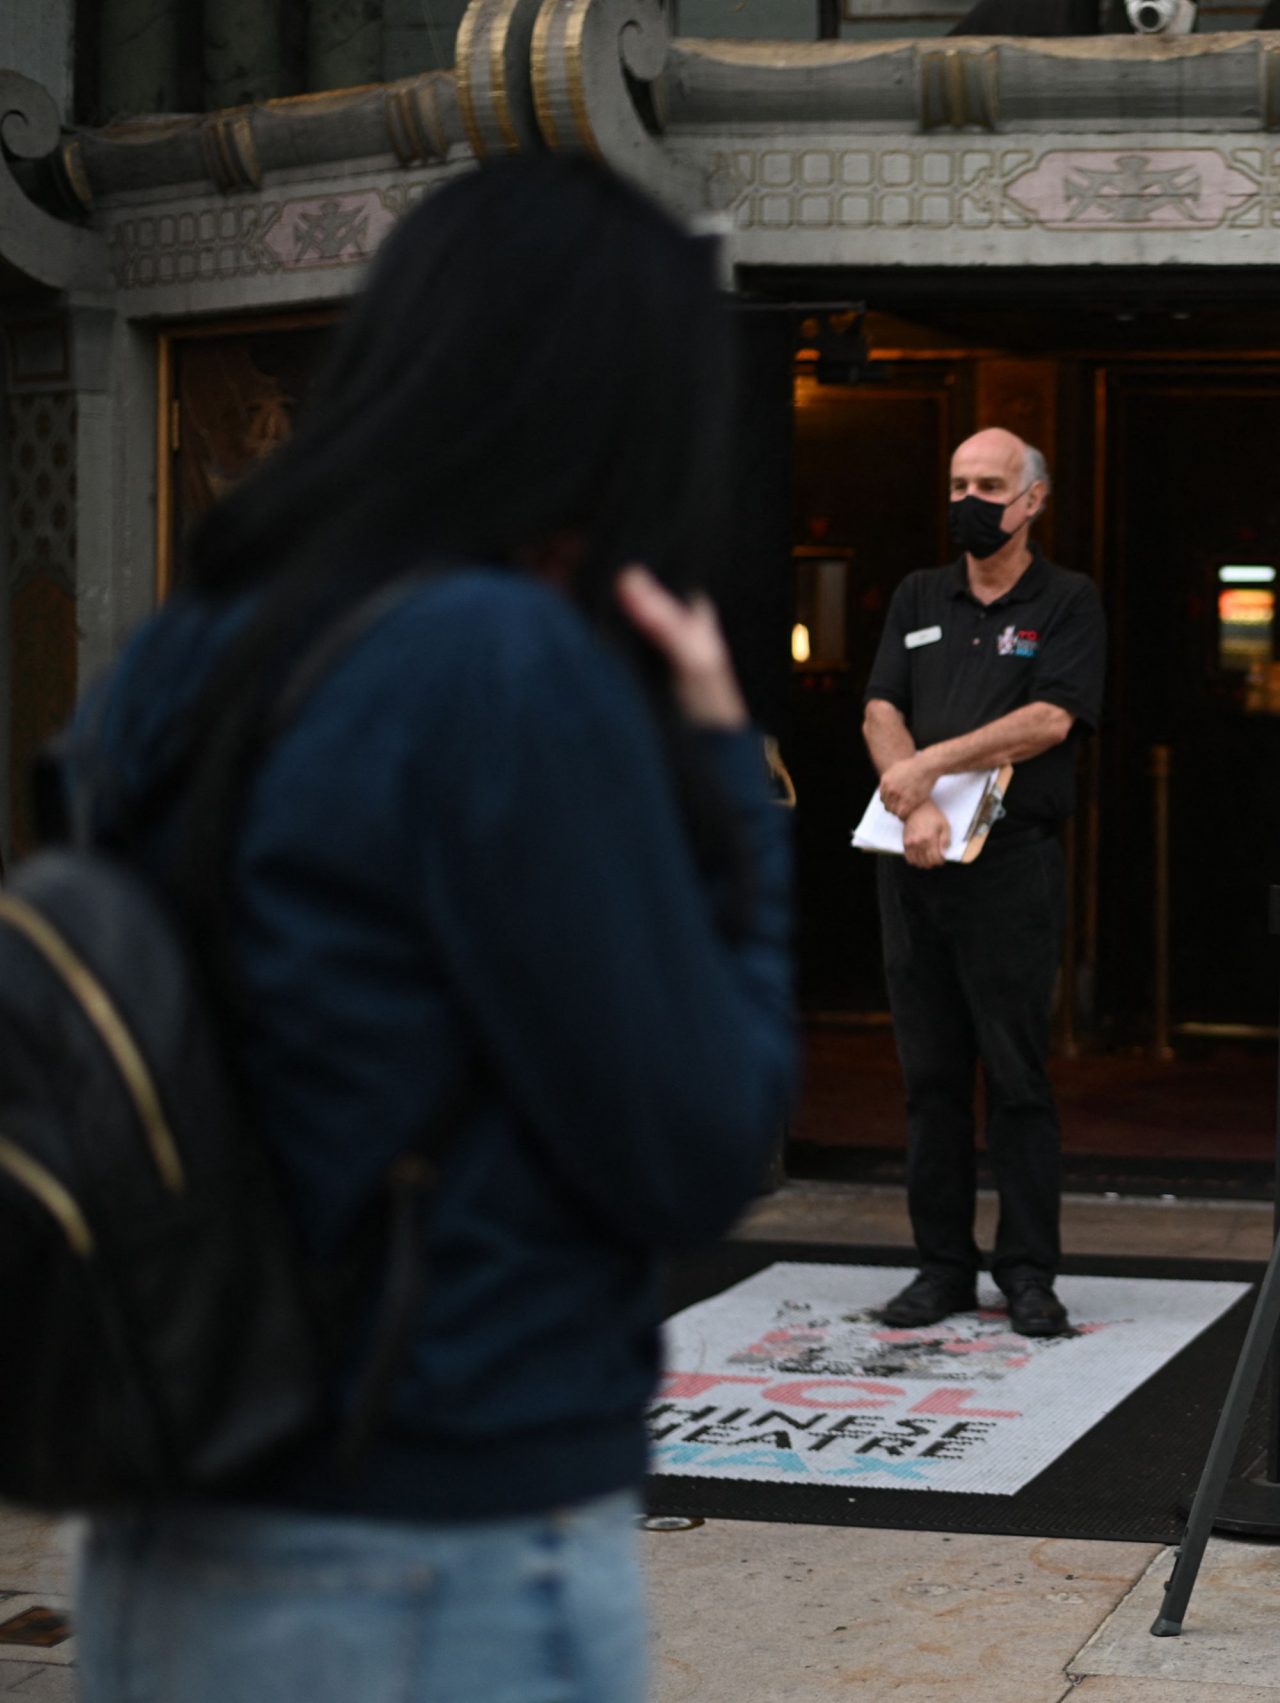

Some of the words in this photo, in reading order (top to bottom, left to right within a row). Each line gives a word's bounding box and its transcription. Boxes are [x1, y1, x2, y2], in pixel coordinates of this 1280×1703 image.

[657, 1371, 1022, 1419] TCL
[643, 1403, 996, 1441] HINESE
[647, 1423, 970, 1459] HEATRE
[649, 1443, 943, 1480] MAX
